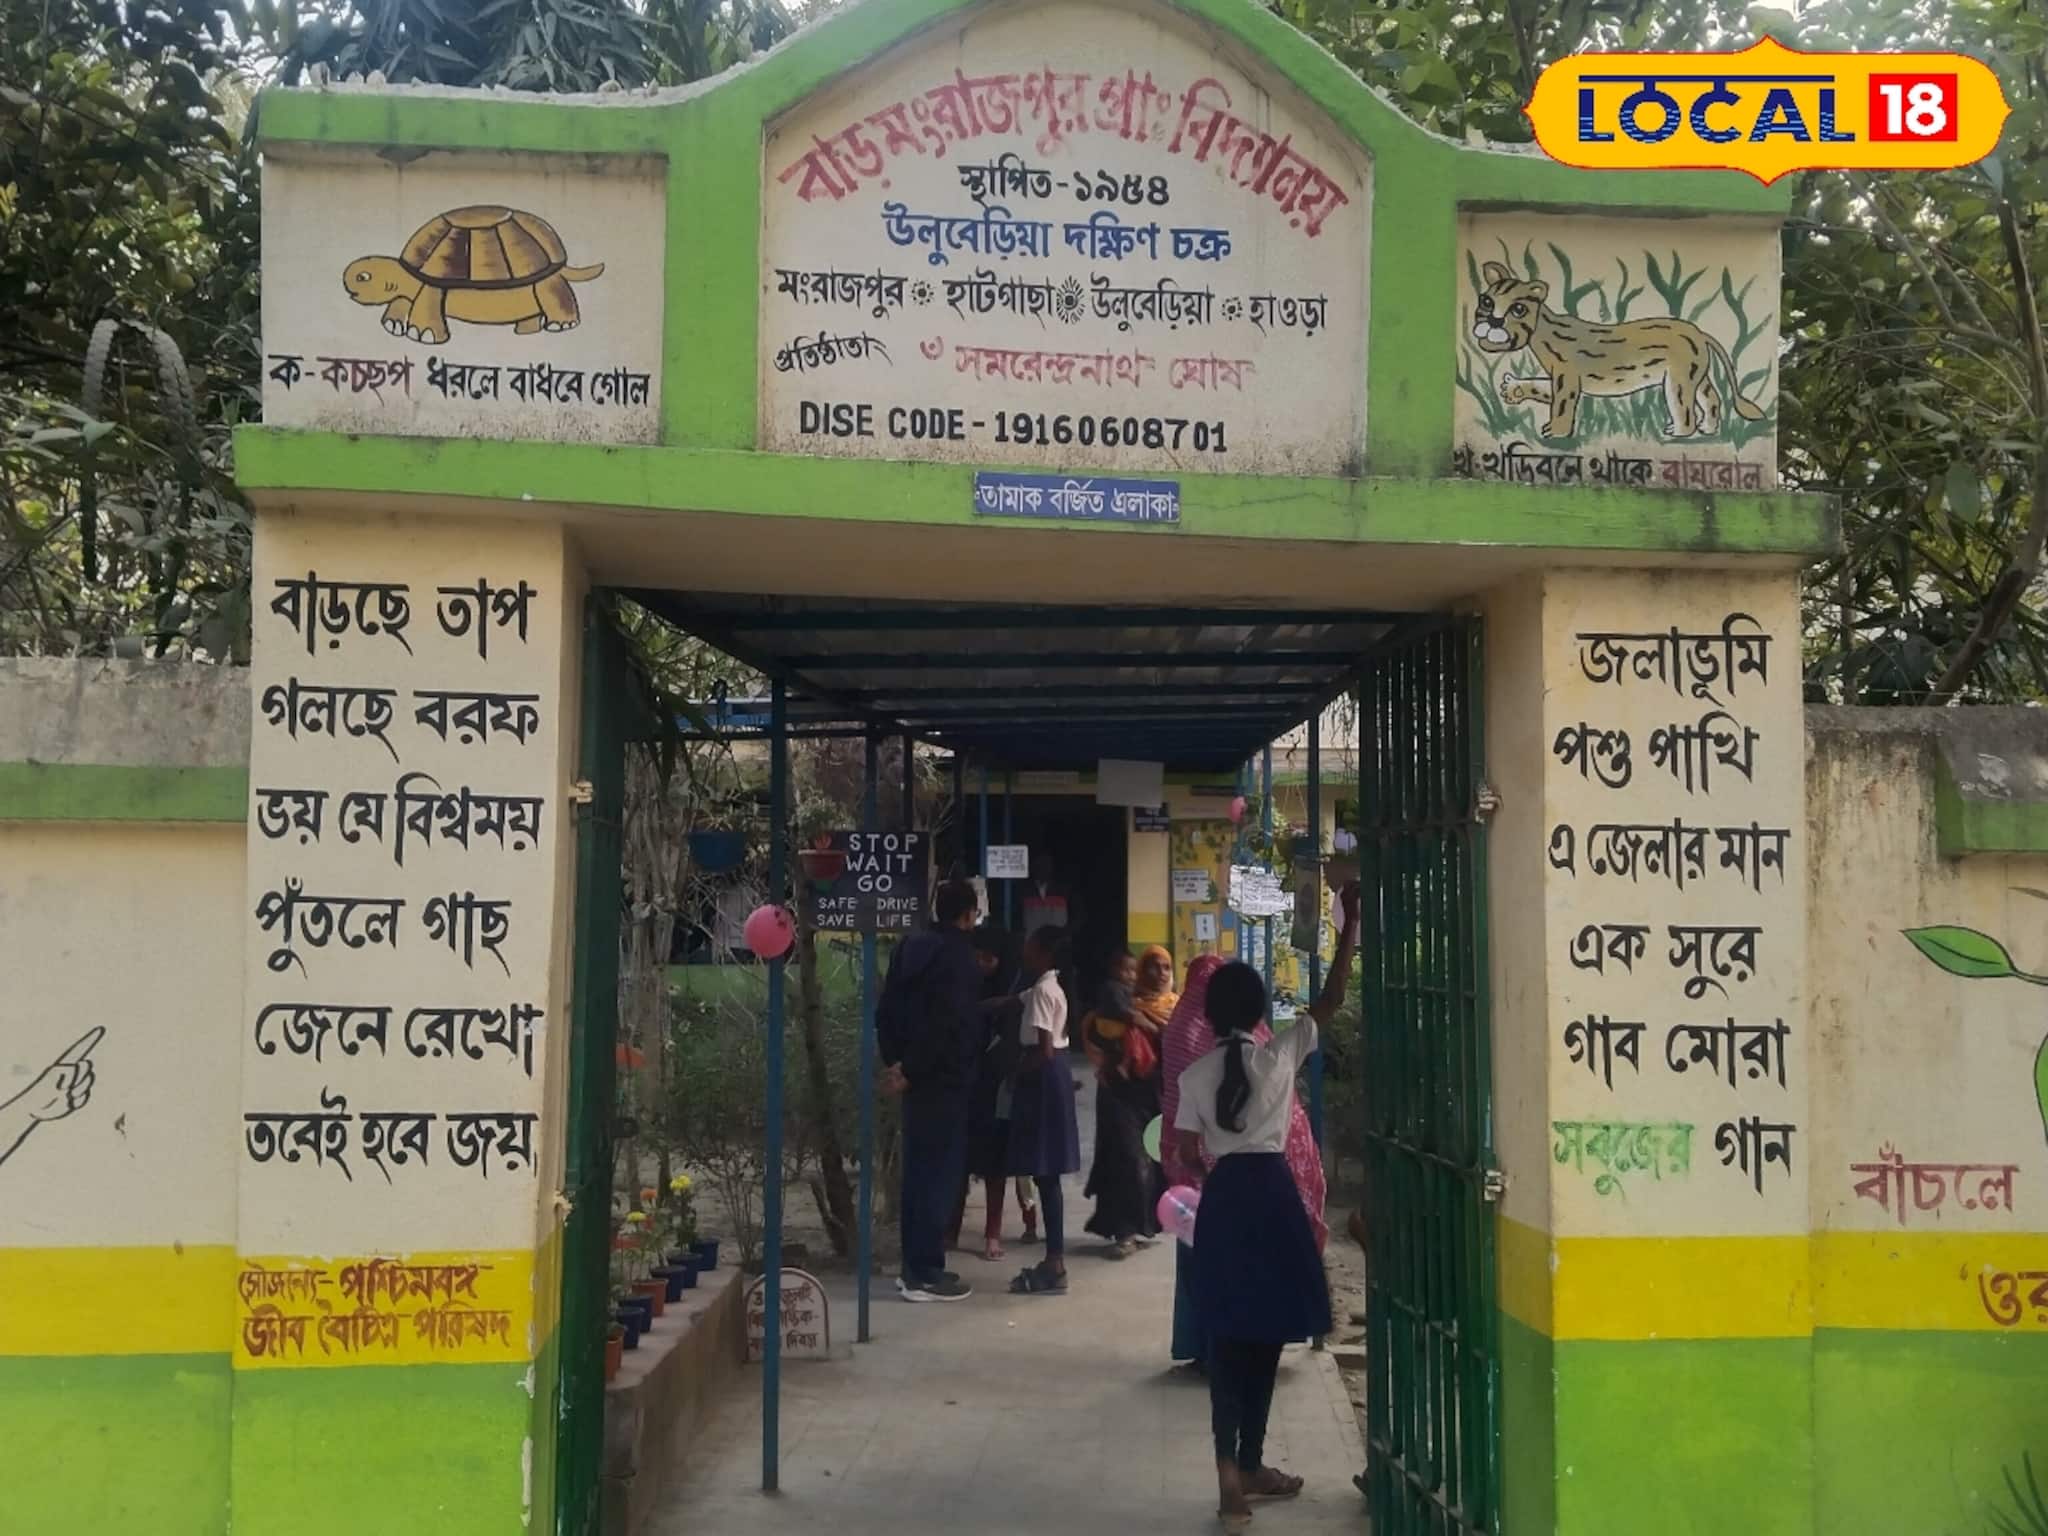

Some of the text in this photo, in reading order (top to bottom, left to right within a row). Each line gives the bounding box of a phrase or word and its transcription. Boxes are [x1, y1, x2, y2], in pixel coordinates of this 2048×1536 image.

[1168, 77, 1349, 238] বিদ্যালয়
[881, 201, 1232, 267] উলুবেড়িয়া দক্ষিণ চক্র
[775, 265, 1328, 337] মংরাজপুর হাটগাছা উলুবেড়িয়া হাওড়া
[427, 355, 501, 400] ধরলে
[507, 362, 584, 403] বাধবে
[590, 367, 651, 408] গোল
[774, 330, 893, 374] প্রতিষ্ঠাতা
[1169, 352, 1256, 391] ঘোষ
[800, 401, 873, 437] DISE
[979, 479, 1175, 520] তামাক বর্জিত এলাকা
[1589, 448, 1654, 486] থাকে
[271, 570, 538, 662] বাড়ছে তাপ
[1575, 612, 1773, 707] জলাভূমি
[261, 676, 540, 764] গলছে বরফ
[1553, 711, 1760, 795] পশু পাখি
[256, 771, 545, 867] ভয় যে বিশ্বময়
[849, 833, 918, 853] STOP
[1549, 817, 1791, 894] এ জেলার মান
[845, 854, 913, 873] WAIT
[857, 875, 892, 892] GO
[255, 875, 512, 979] পুঁতলে গাছ
[816, 914, 912, 927] SAVE LIFE
[818, 897, 919, 911] SAFE DRIVE
[1570, 924, 1763, 1000] এক সুরে
[255, 1003, 545, 1080] জেনে রেখো
[1564, 1014, 1791, 1092] গাব মোরা
[243, 1085, 352, 1182] তবেই
[360, 1112, 437, 1185] হবে
[1552, 1116, 1796, 1200] সবুজের গান
[1851, 1140, 2020, 1227] বাঁচলে
[244, 1302, 314, 1358] জীব
[412, 1300, 513, 1349] পরিষদ
